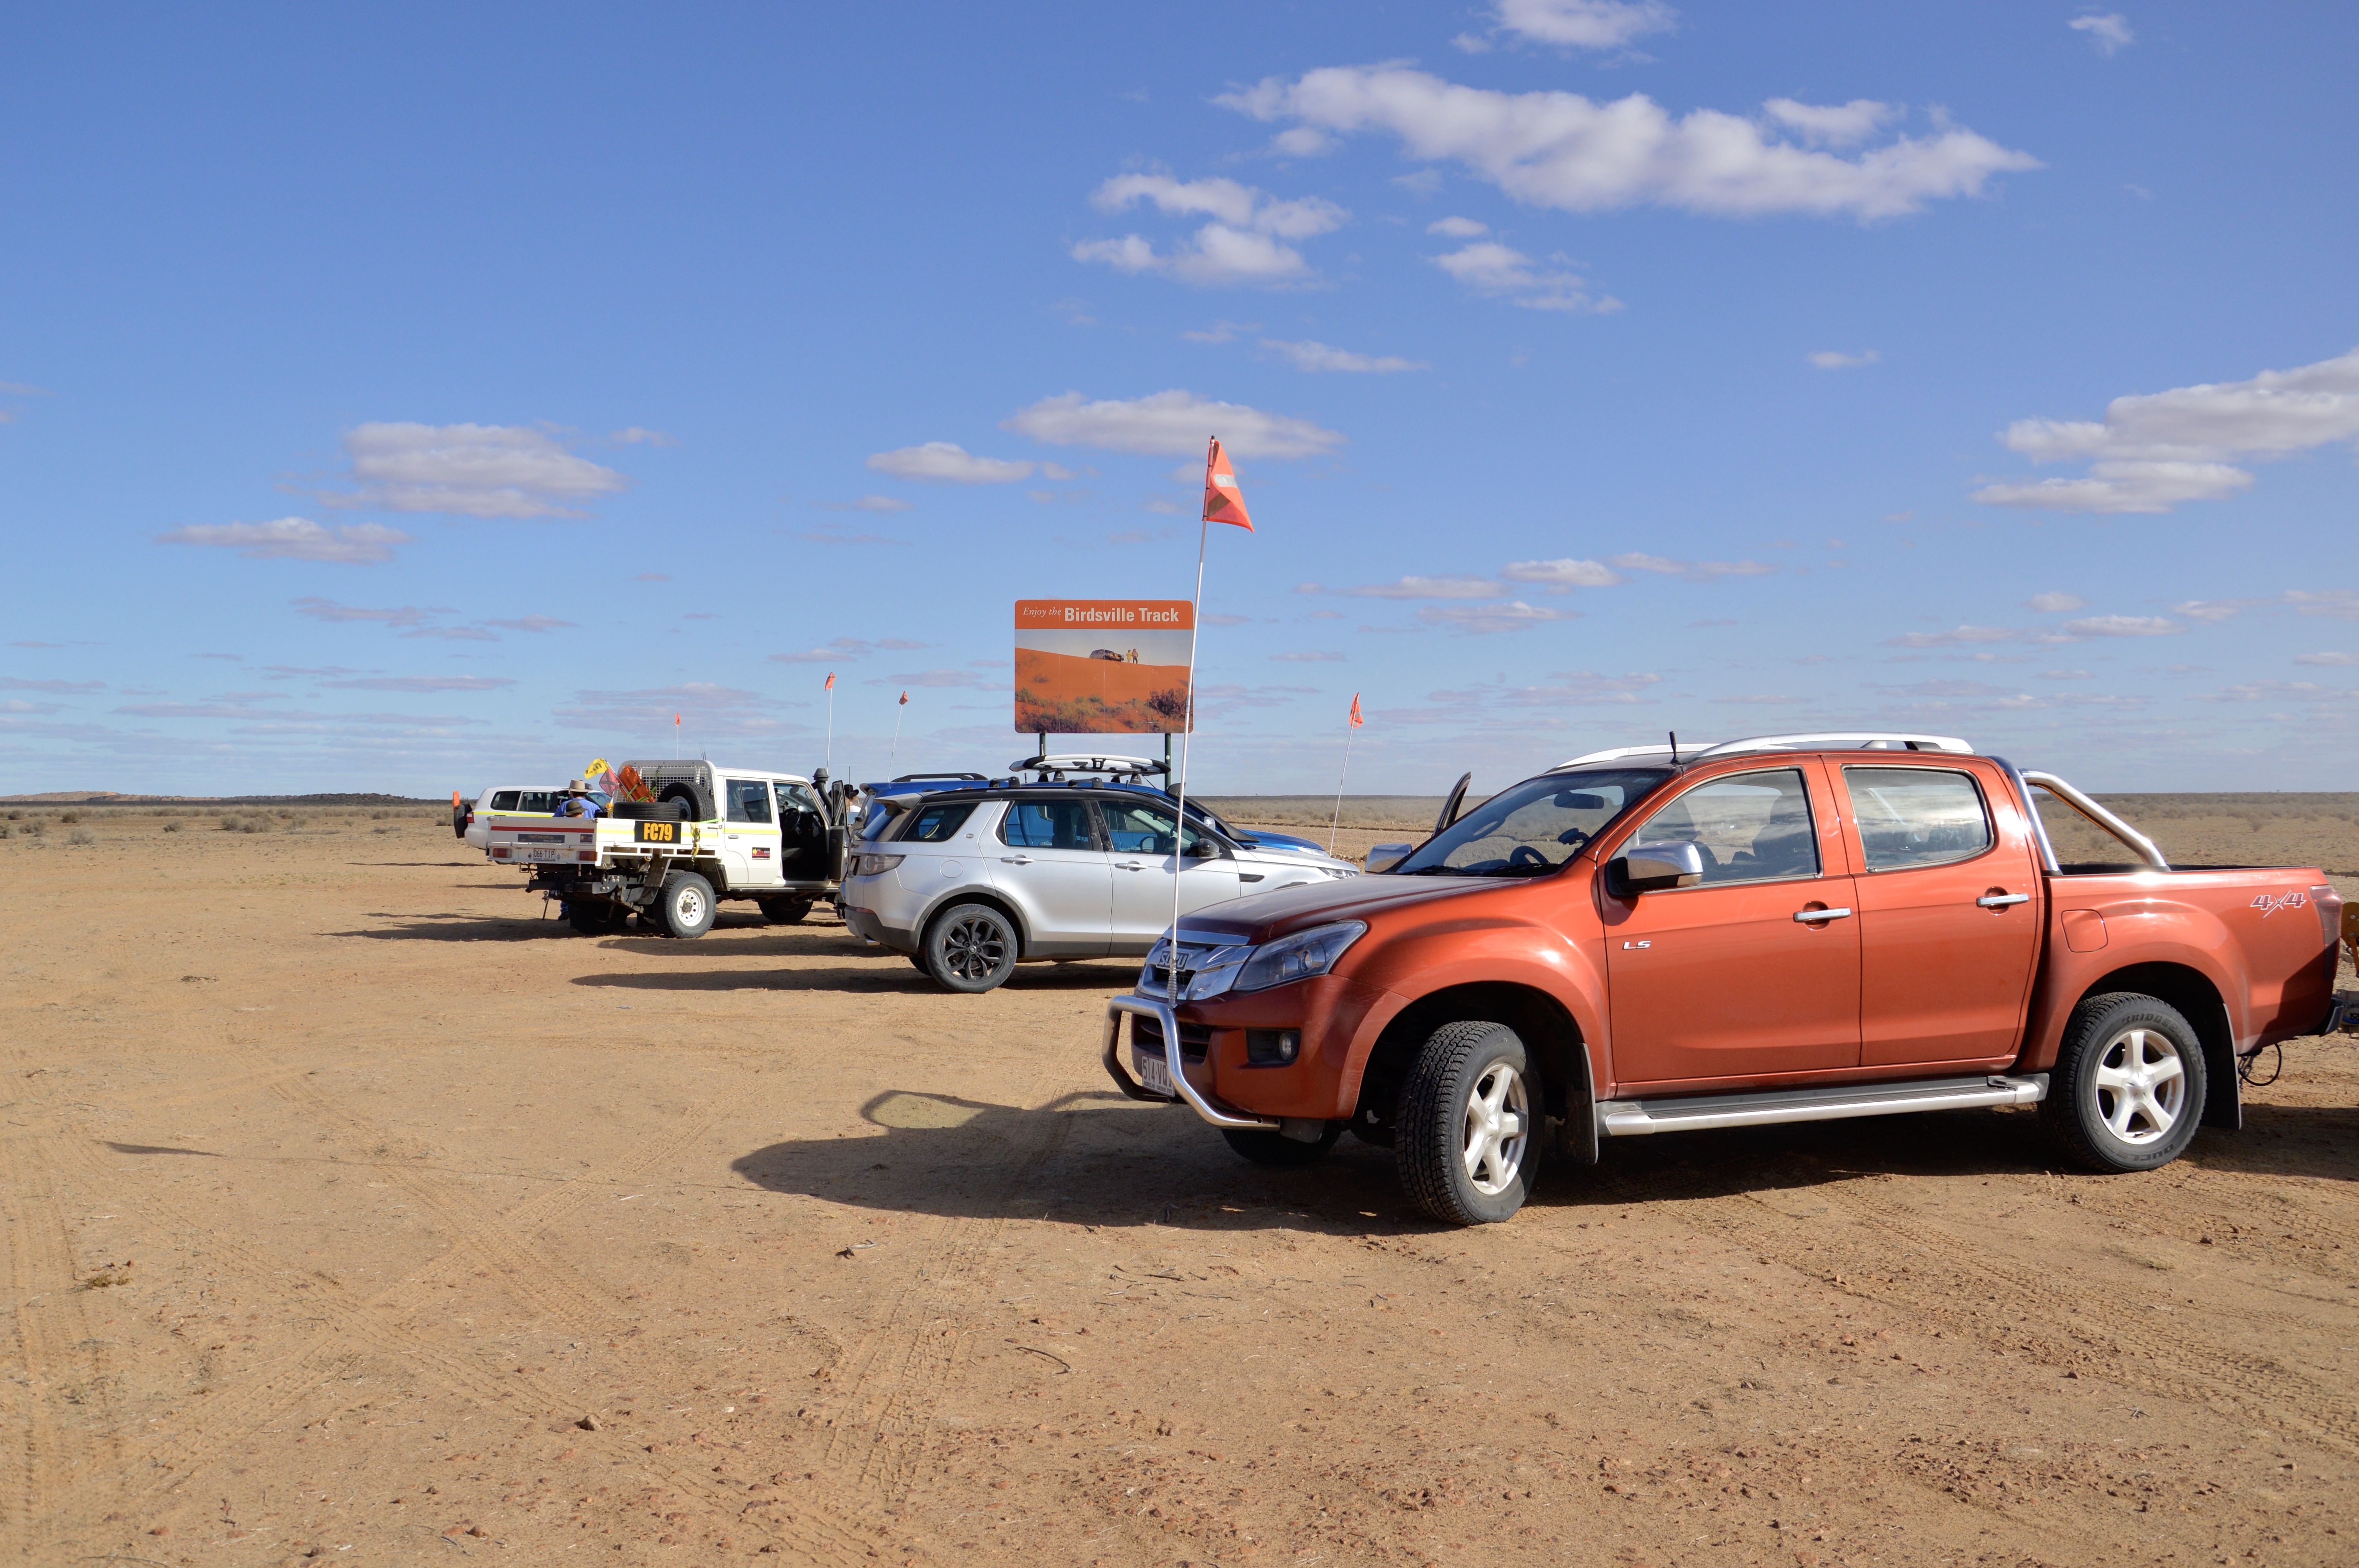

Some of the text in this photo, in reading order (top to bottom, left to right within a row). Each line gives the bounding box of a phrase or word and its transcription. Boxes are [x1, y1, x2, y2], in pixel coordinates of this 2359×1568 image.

[1023, 607, 1179, 622] Enjoy the Birdsville Track
[644, 823, 672, 841] FC79
[1623, 941, 1651, 950] LS
[2121, 1013, 2198, 1065] BRIDGESTONE
